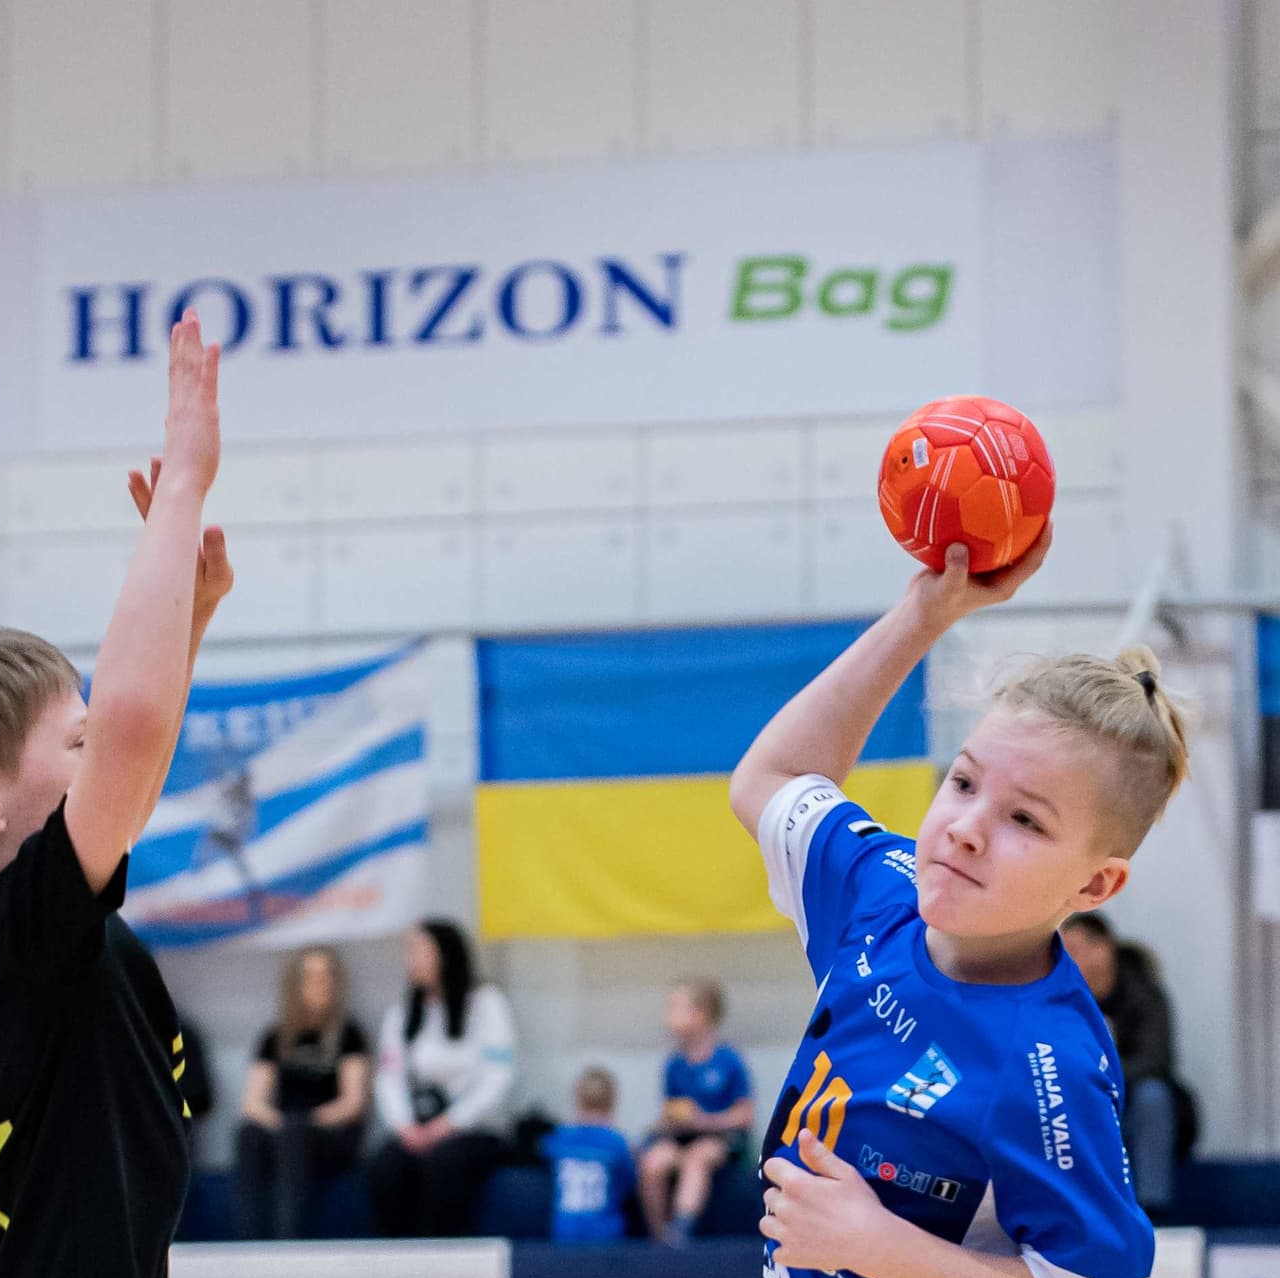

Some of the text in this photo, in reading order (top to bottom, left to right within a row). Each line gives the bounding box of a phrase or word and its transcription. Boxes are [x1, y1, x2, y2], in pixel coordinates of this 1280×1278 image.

[63, 253, 955, 366] HORIZON Bag
[867, 983, 917, 1043] SU.VI
[1035, 1042, 1074, 1170] ANIJA VALD
[857, 1144, 932, 1193] Mobil
